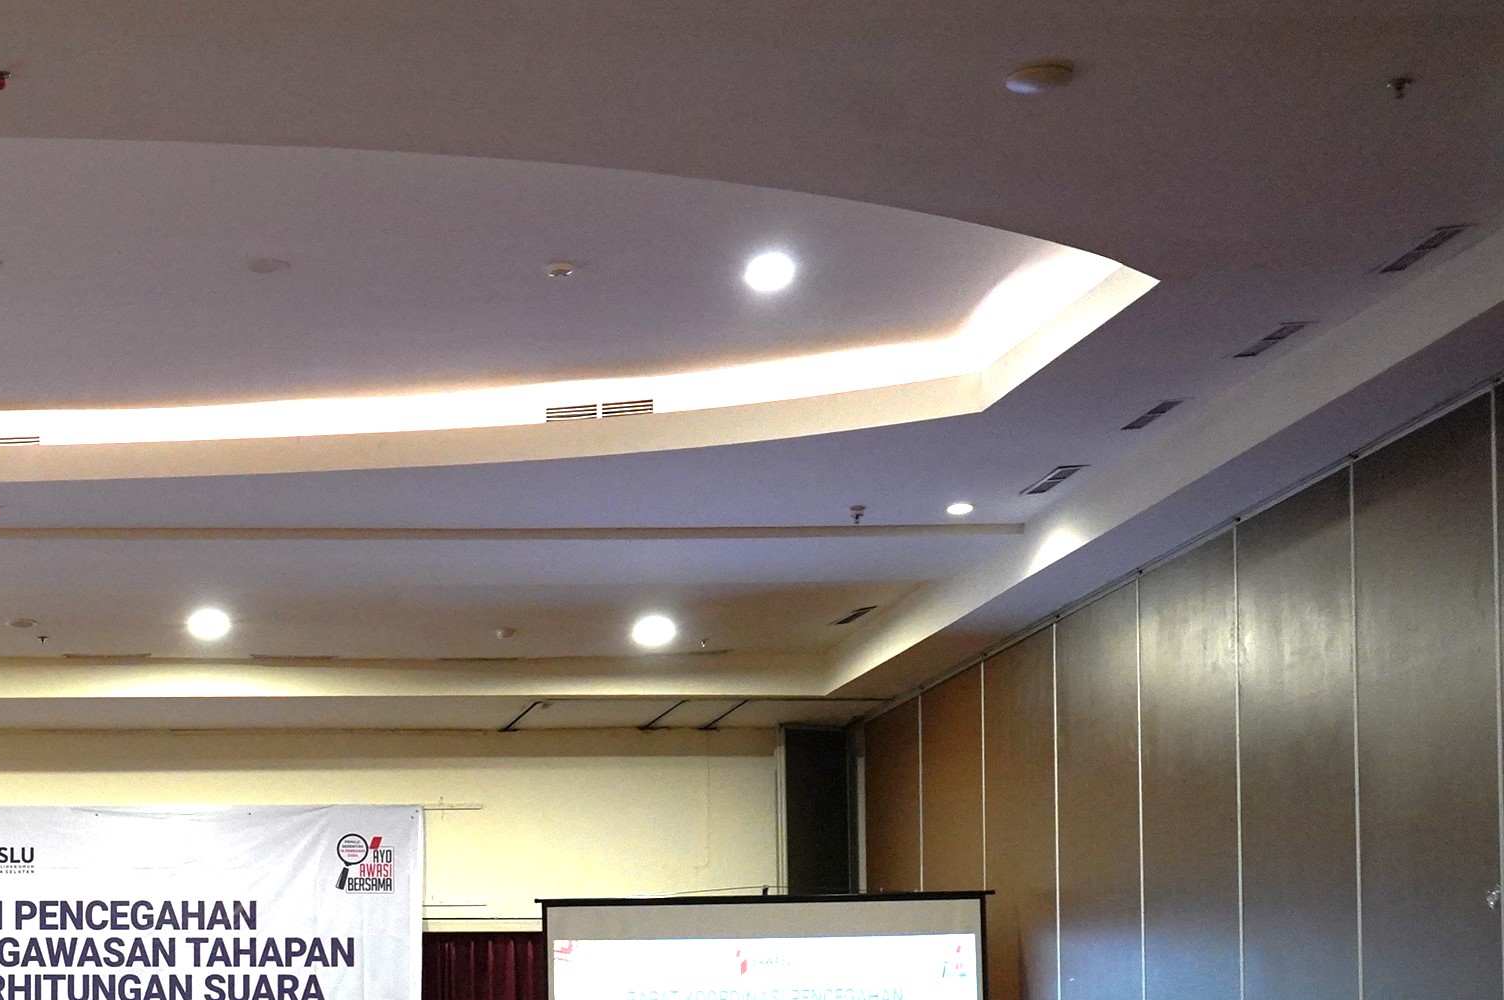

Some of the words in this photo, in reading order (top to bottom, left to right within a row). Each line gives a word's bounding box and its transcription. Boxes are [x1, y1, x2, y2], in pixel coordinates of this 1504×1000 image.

[373, 849, 392, 863] AYO
[359, 863, 393, 877] AWASI
[347, 877, 393, 892] BERSAMA
[15, 900, 257, 930] PENCEGAHAN
[186, 938, 355, 968] TAHAPAN
